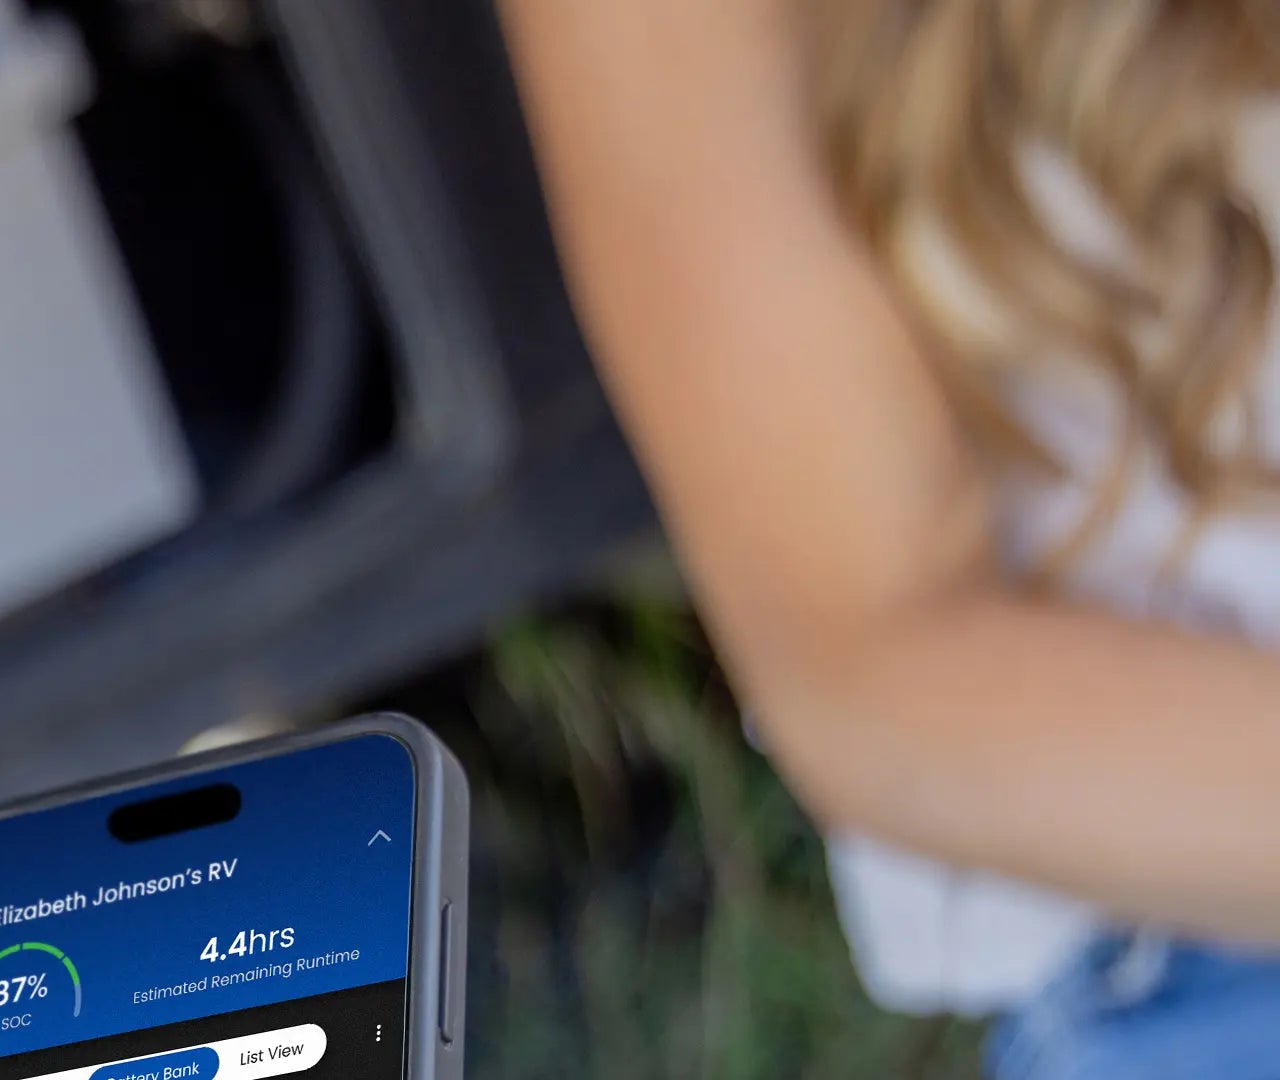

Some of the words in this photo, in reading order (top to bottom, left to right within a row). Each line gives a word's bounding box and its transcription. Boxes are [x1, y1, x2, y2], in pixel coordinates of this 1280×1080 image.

[92, 868, 202, 906] Johnson’s
[208, 858, 238, 881] RV
[199, 927, 295, 963] 4.4hrs
[133, 977, 207, 1004] Estimated
[211, 962, 293, 989] Remaining
[296, 949, 361, 971] Runtime
[1, 1013, 32, 1030] SOC
[239, 1050, 264, 1066] List
[268, 1042, 304, 1060] View
[163, 1062, 200, 1080] Bank
